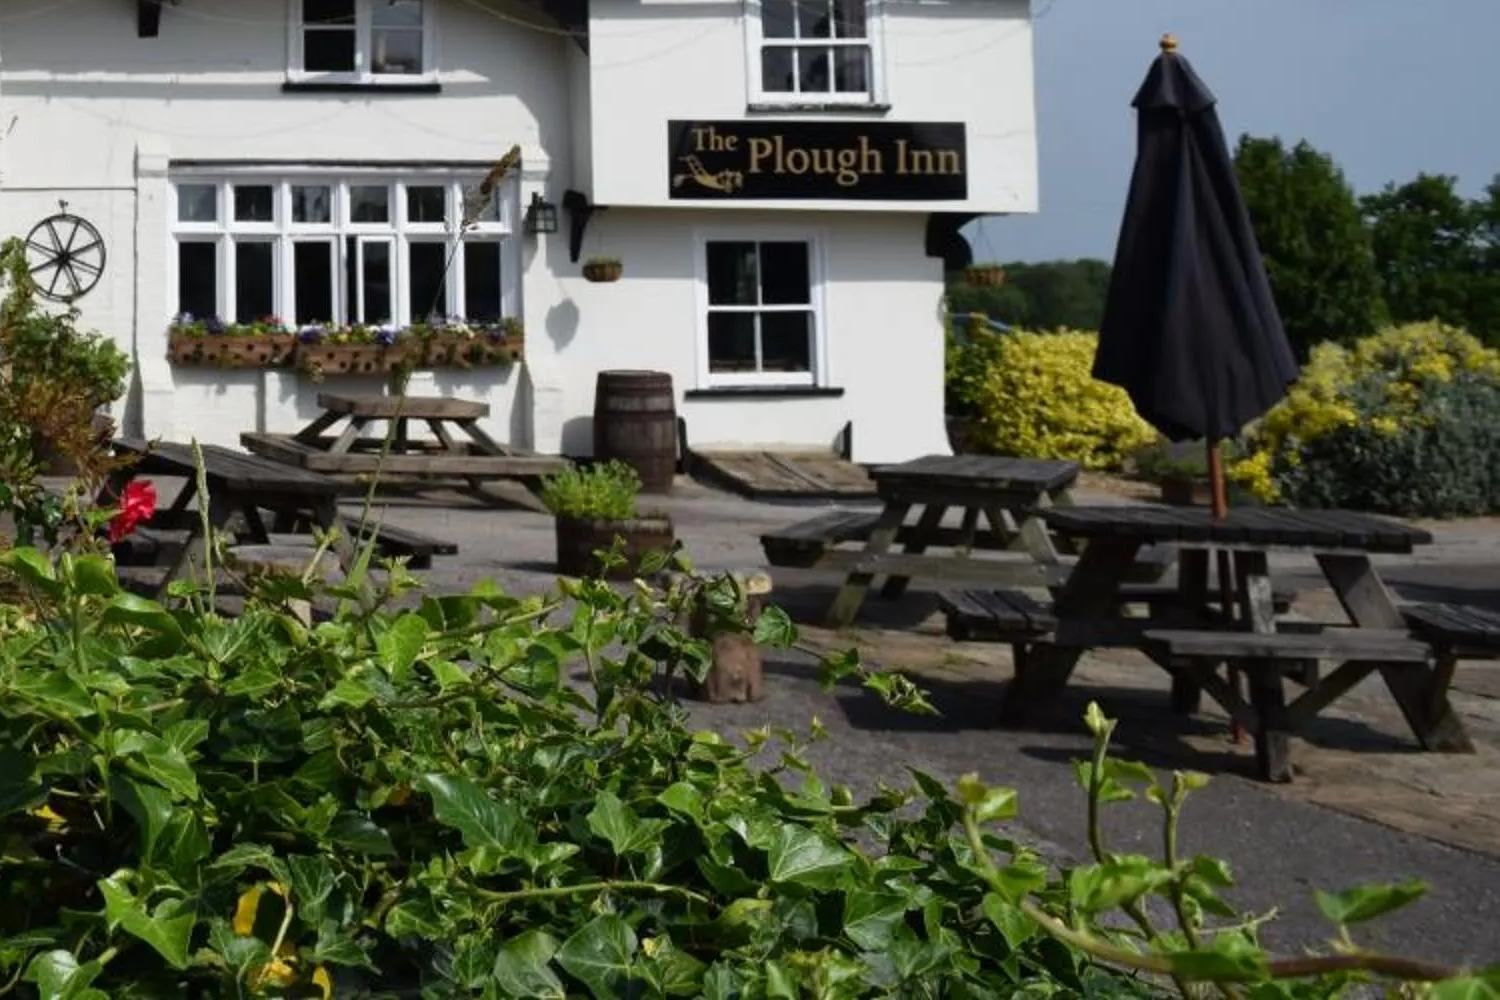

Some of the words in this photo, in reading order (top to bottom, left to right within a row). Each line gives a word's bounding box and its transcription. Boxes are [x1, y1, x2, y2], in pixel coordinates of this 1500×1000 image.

[692, 128, 738, 151] The
[748, 135, 884, 186] Plough
[895, 139, 962, 175] Inn
